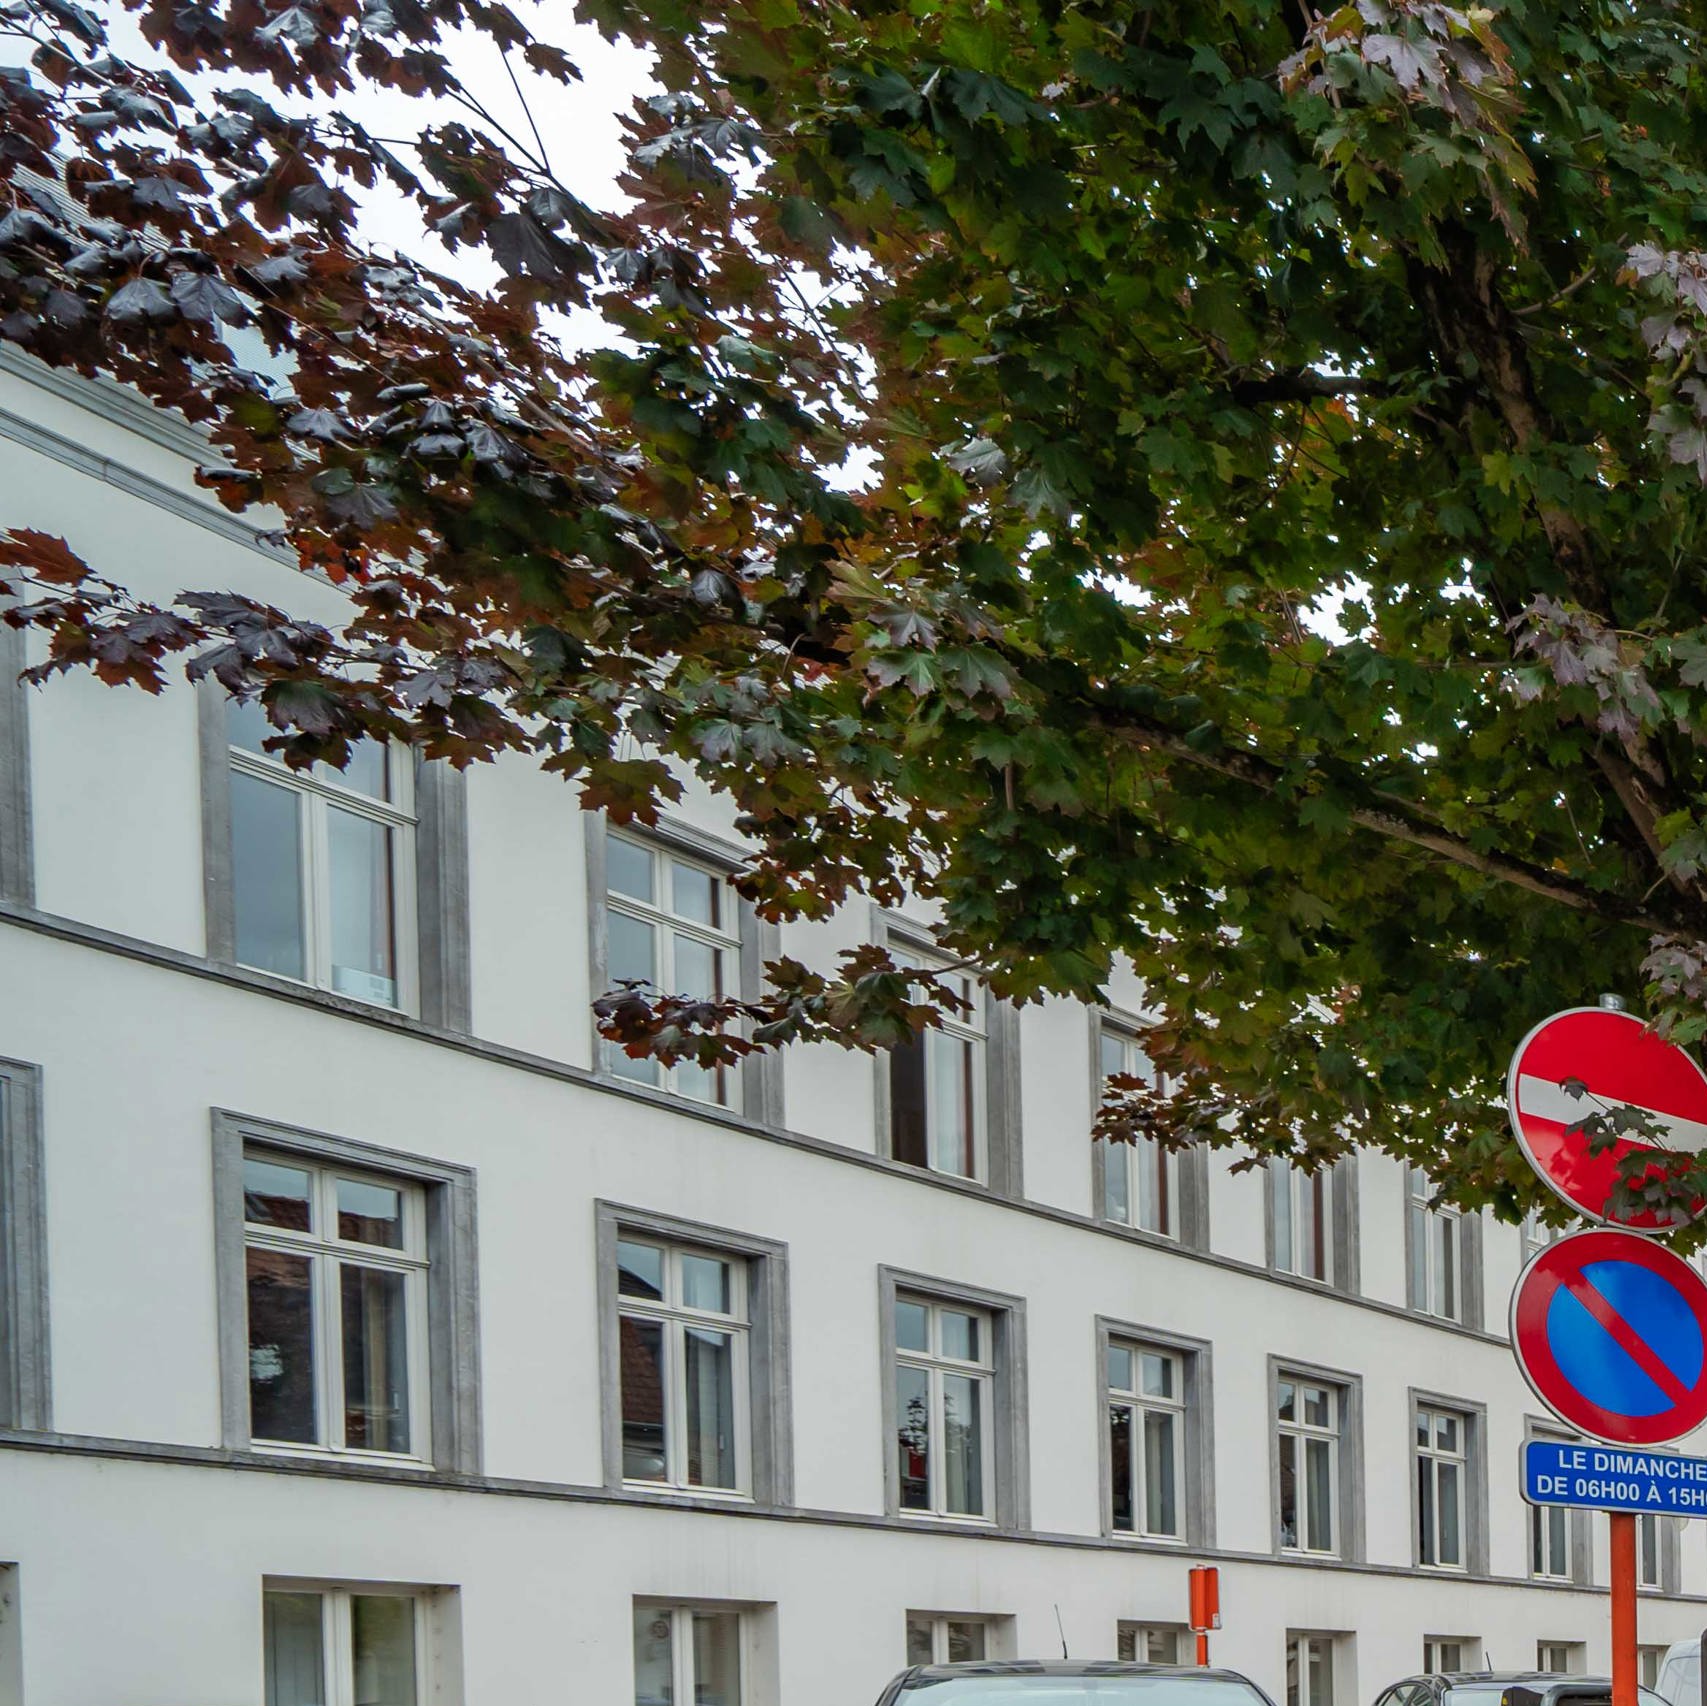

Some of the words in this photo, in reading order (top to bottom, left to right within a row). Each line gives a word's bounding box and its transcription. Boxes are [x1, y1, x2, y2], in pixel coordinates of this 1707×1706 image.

[1558, 1450, 1587, 1470] LE
[1594, 1453, 1707, 1482] DIMANCHE
[1537, 1475, 1568, 1496] DE
[1575, 1478, 1640, 1501] 06H00
[1646, 1480, 1662, 1503] À
